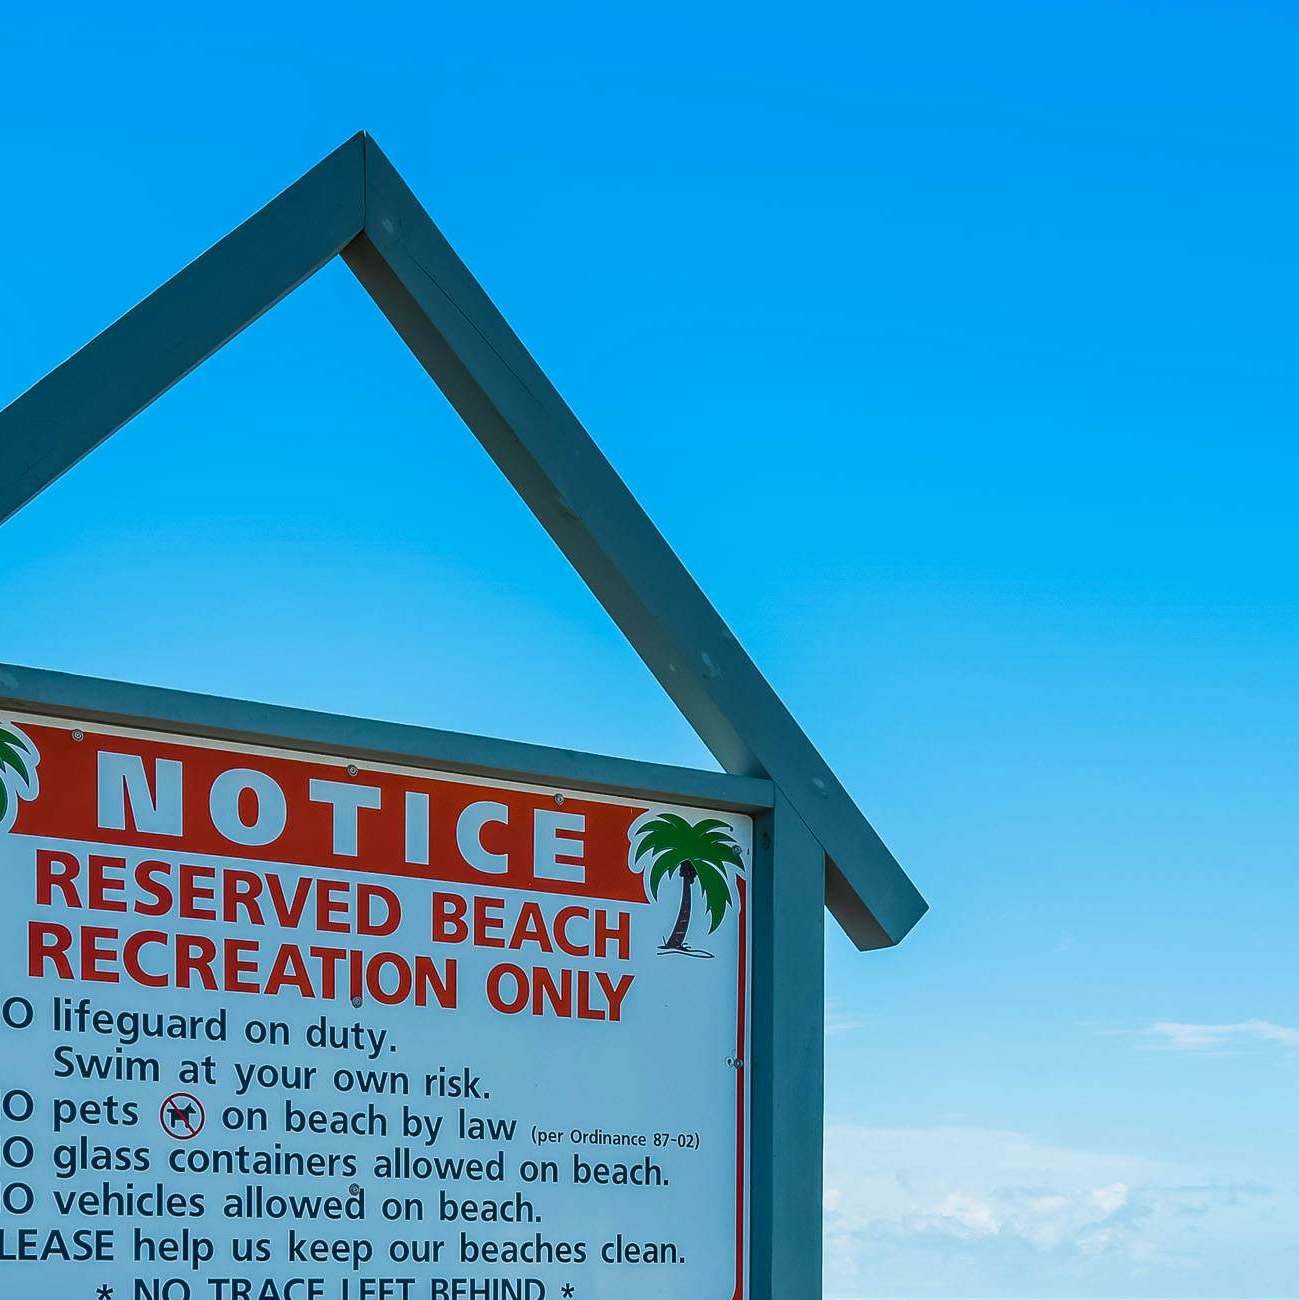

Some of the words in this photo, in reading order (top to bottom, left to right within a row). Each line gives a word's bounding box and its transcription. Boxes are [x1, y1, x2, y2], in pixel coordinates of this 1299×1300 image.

[97, 750, 585, 883] NOTICE
[36, 848, 401, 936] RESERVED
[431, 891, 630, 960] BEACH
[28, 921, 456, 1008] RECREATION
[486, 962, 633, 1021] ONLY
[53, 996, 226, 1044] lifeguard
[245, 1020, 289, 1045] on
[306, 1015, 395, 1059] duty.
[54, 1045, 159, 1081] Swim
[178, 1055, 216, 1084] at
[234, 1063, 316, 1095] your
[333, 1069, 408, 1094] own
[425, 1066, 489, 1098] risk.
[53, 1095, 137, 1132] pets
[222, 1106, 266, 1130] on
[285, 1099, 386, 1136] beach
[403, 1105, 442, 1145] by
[459, 1108, 516, 1140] law
[531, 1125, 563, 1146] (per
[570, 1128, 646, 1146] Ordinance
[653, 1132, 699, 1150] 87-02)
[53, 1135, 149, 1178] glass
[168, 1143, 356, 1176] containers
[373, 1146, 503, 1180] allowed
[520, 1160, 557, 1182] on
[573, 1153, 668, 1185] beach.
[53, 1181, 204, 1216] vehicles
[223, 1182, 364, 1219] allowed
[381, 1198, 422, 1220] on
[439, 1190, 541, 1222] beach.
[133, 1227, 213, 1270] help
[232, 1238, 270, 1261] us
[289, 1229, 372, 1270] keep
[389, 1240, 444, 1262] our
[460, 1231, 586, 1262] beaches
[601, 1233, 684, 1263] clean.
